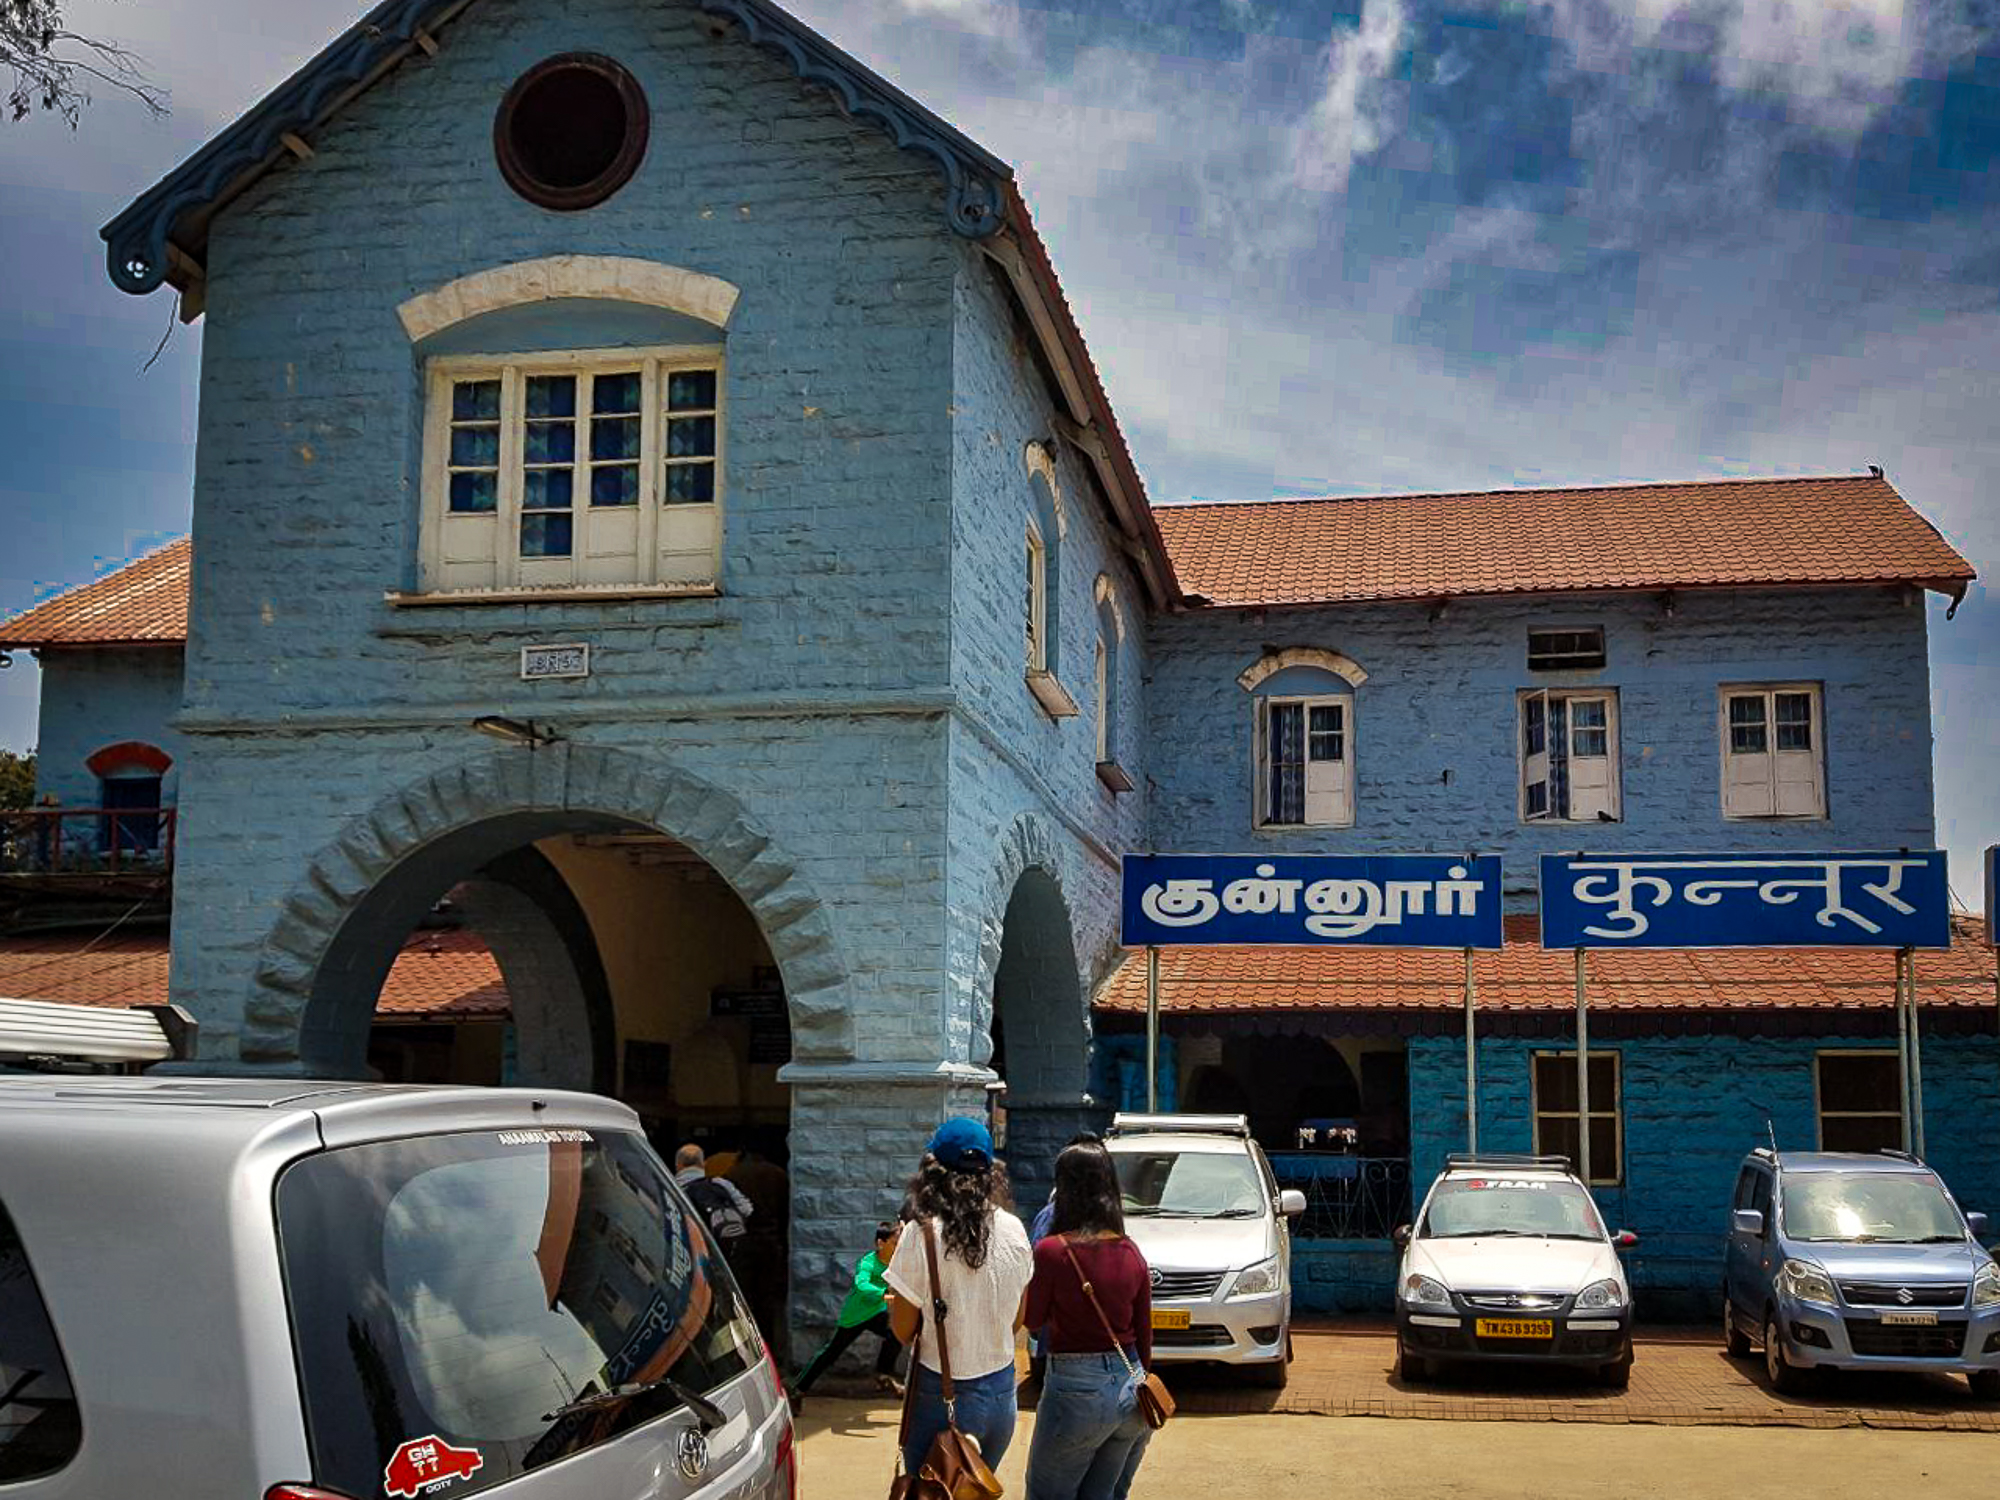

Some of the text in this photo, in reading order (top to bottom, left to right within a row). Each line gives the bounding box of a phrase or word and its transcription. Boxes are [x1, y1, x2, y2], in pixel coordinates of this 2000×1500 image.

[1141, 863, 1485, 938] குன்னூர்
[1567, 859, 1929, 939] कुन्नूर
[425, 1479, 452, 1493] OOTY
